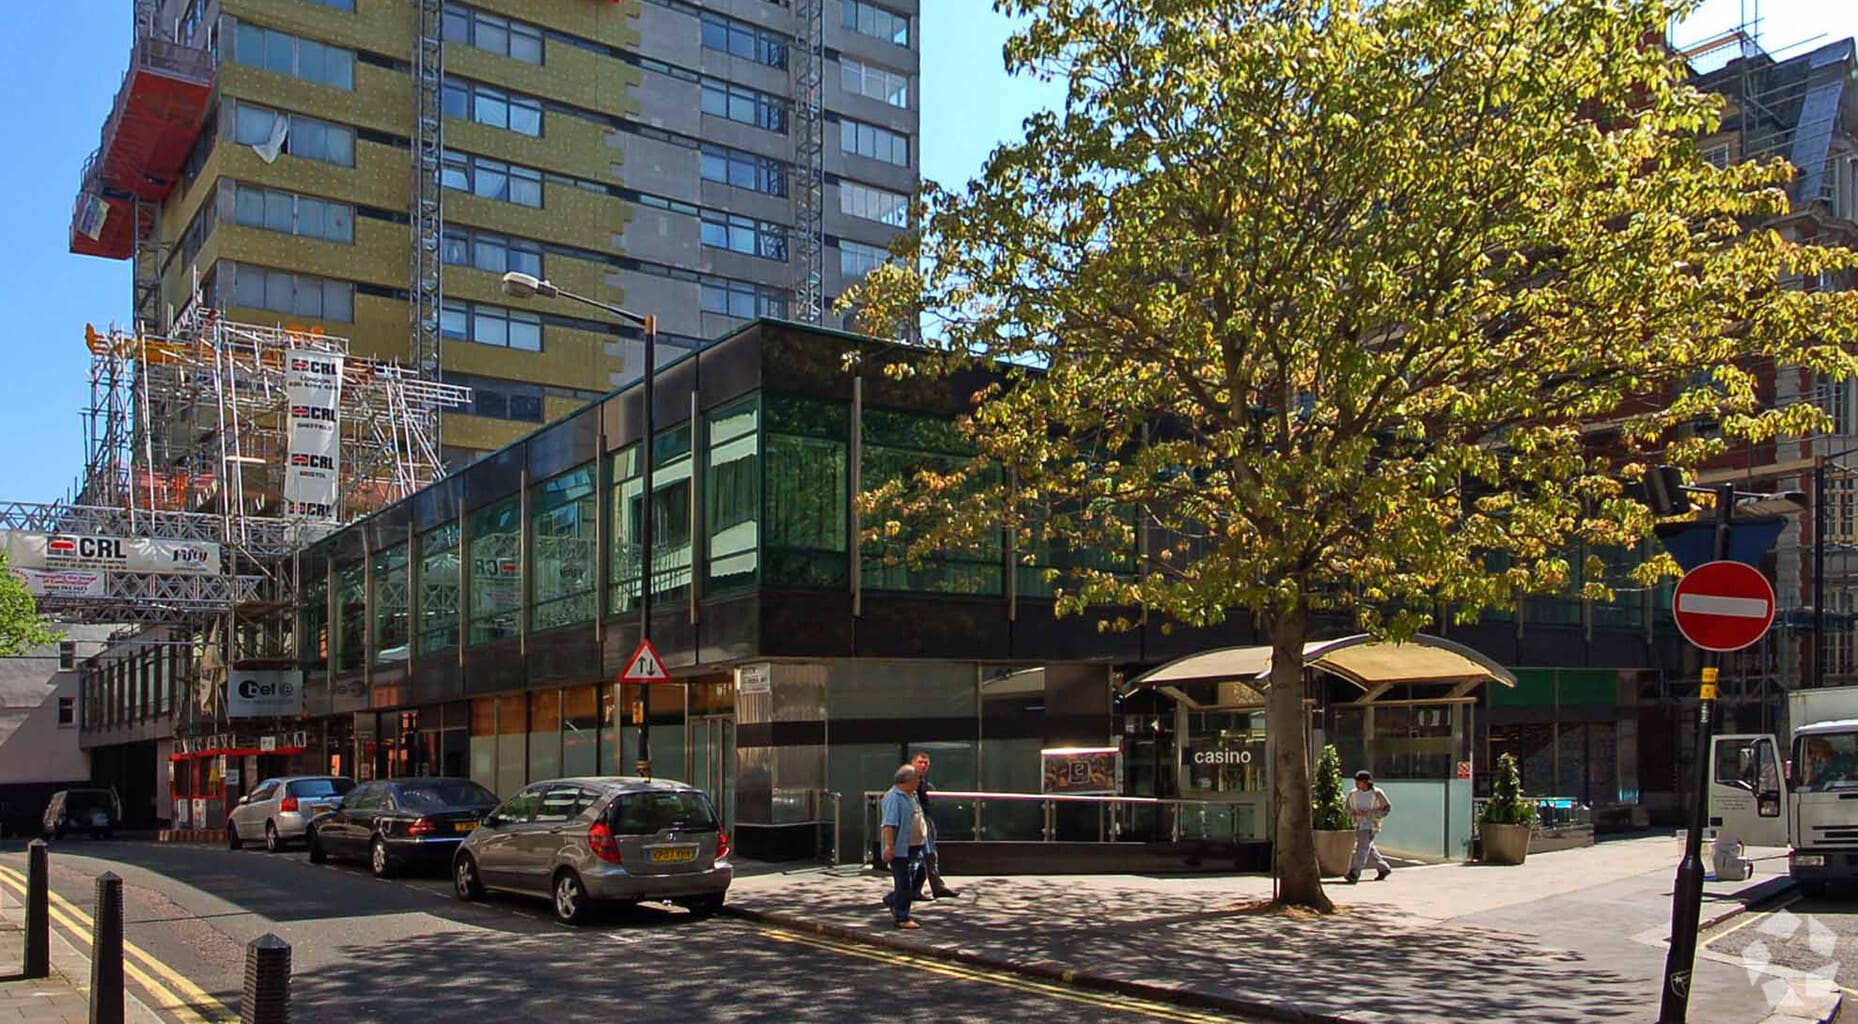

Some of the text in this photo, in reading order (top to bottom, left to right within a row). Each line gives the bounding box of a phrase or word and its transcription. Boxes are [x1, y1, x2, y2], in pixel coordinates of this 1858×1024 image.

[311, 361, 337, 375] CRL
[311, 407, 336, 422] CRL
[310, 455, 334, 470] CRL
[80, 538, 127, 558] CRL
[1194, 747, 1252, 764] casino
